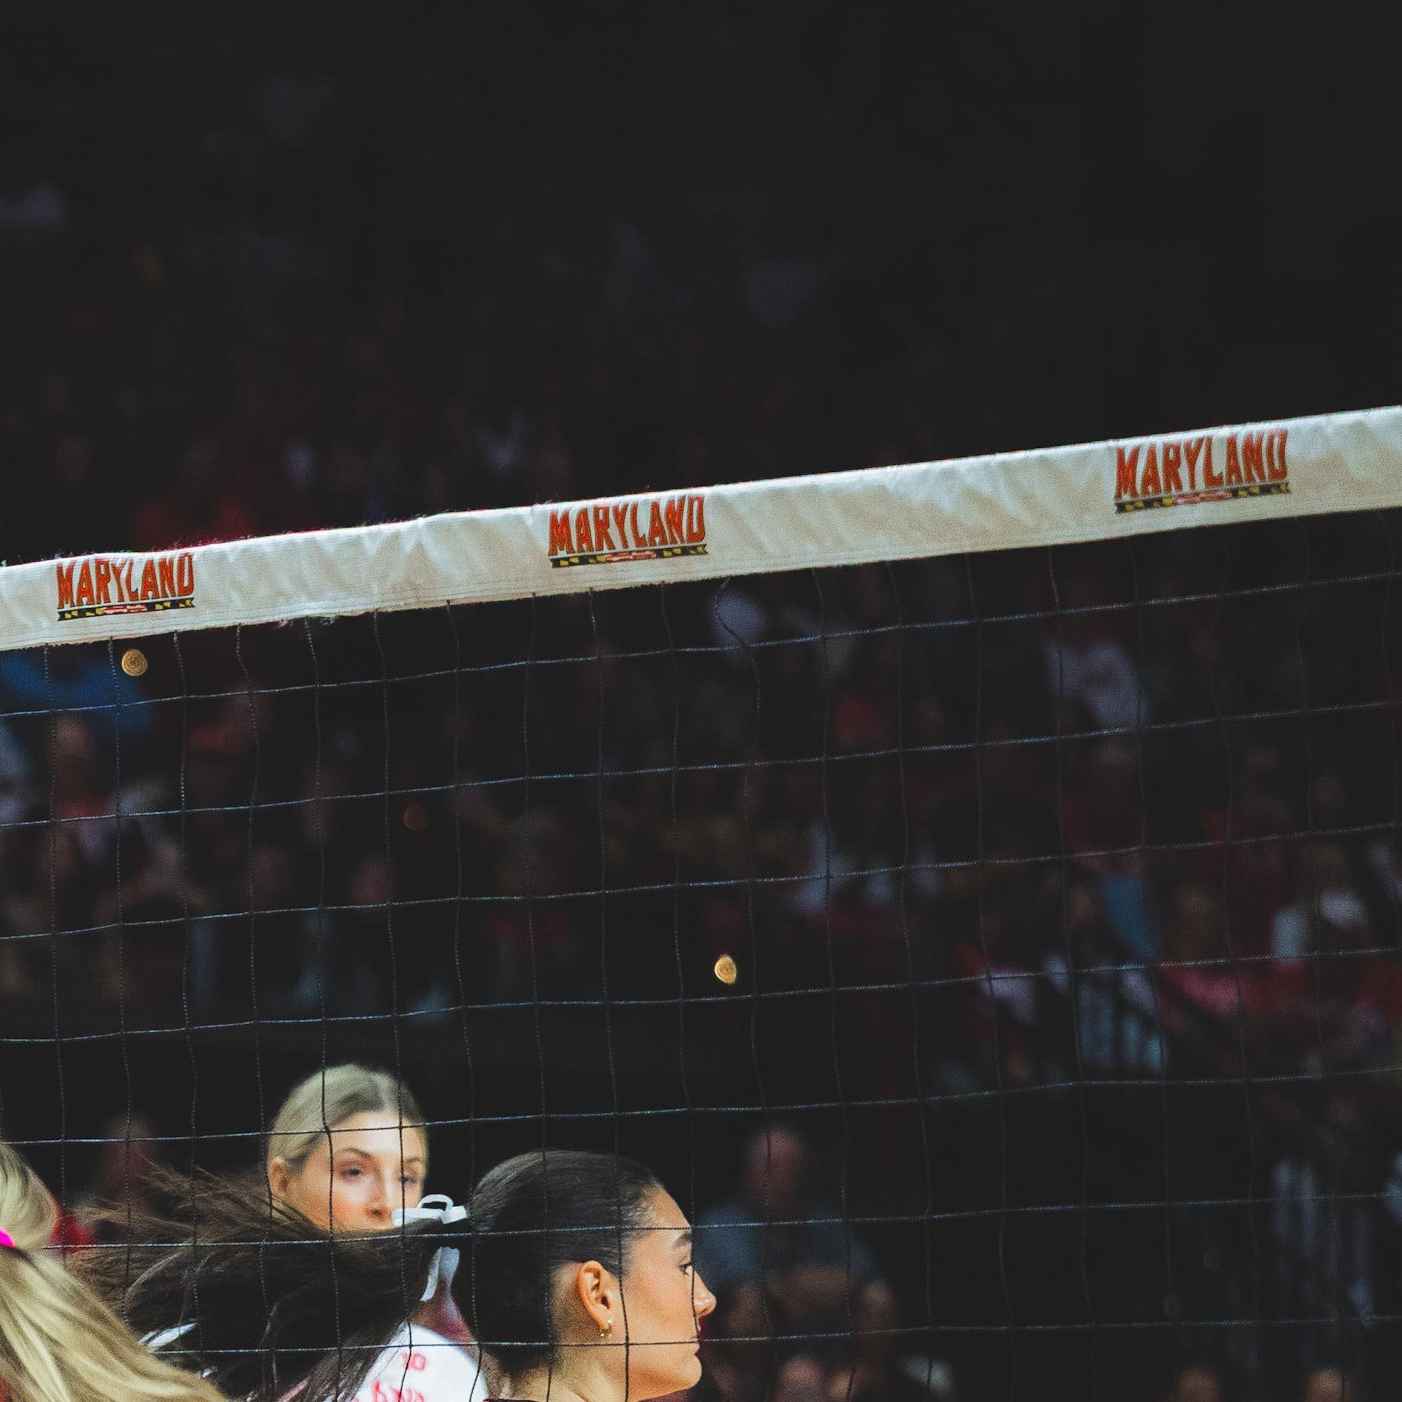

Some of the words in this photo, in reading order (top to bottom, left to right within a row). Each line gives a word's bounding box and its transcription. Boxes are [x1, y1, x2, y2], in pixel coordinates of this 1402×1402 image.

[1114, 429, 1288, 501] MARYLAND
[548, 495, 706, 557] MARYLAND
[56, 552, 195, 610] MARYLAND
